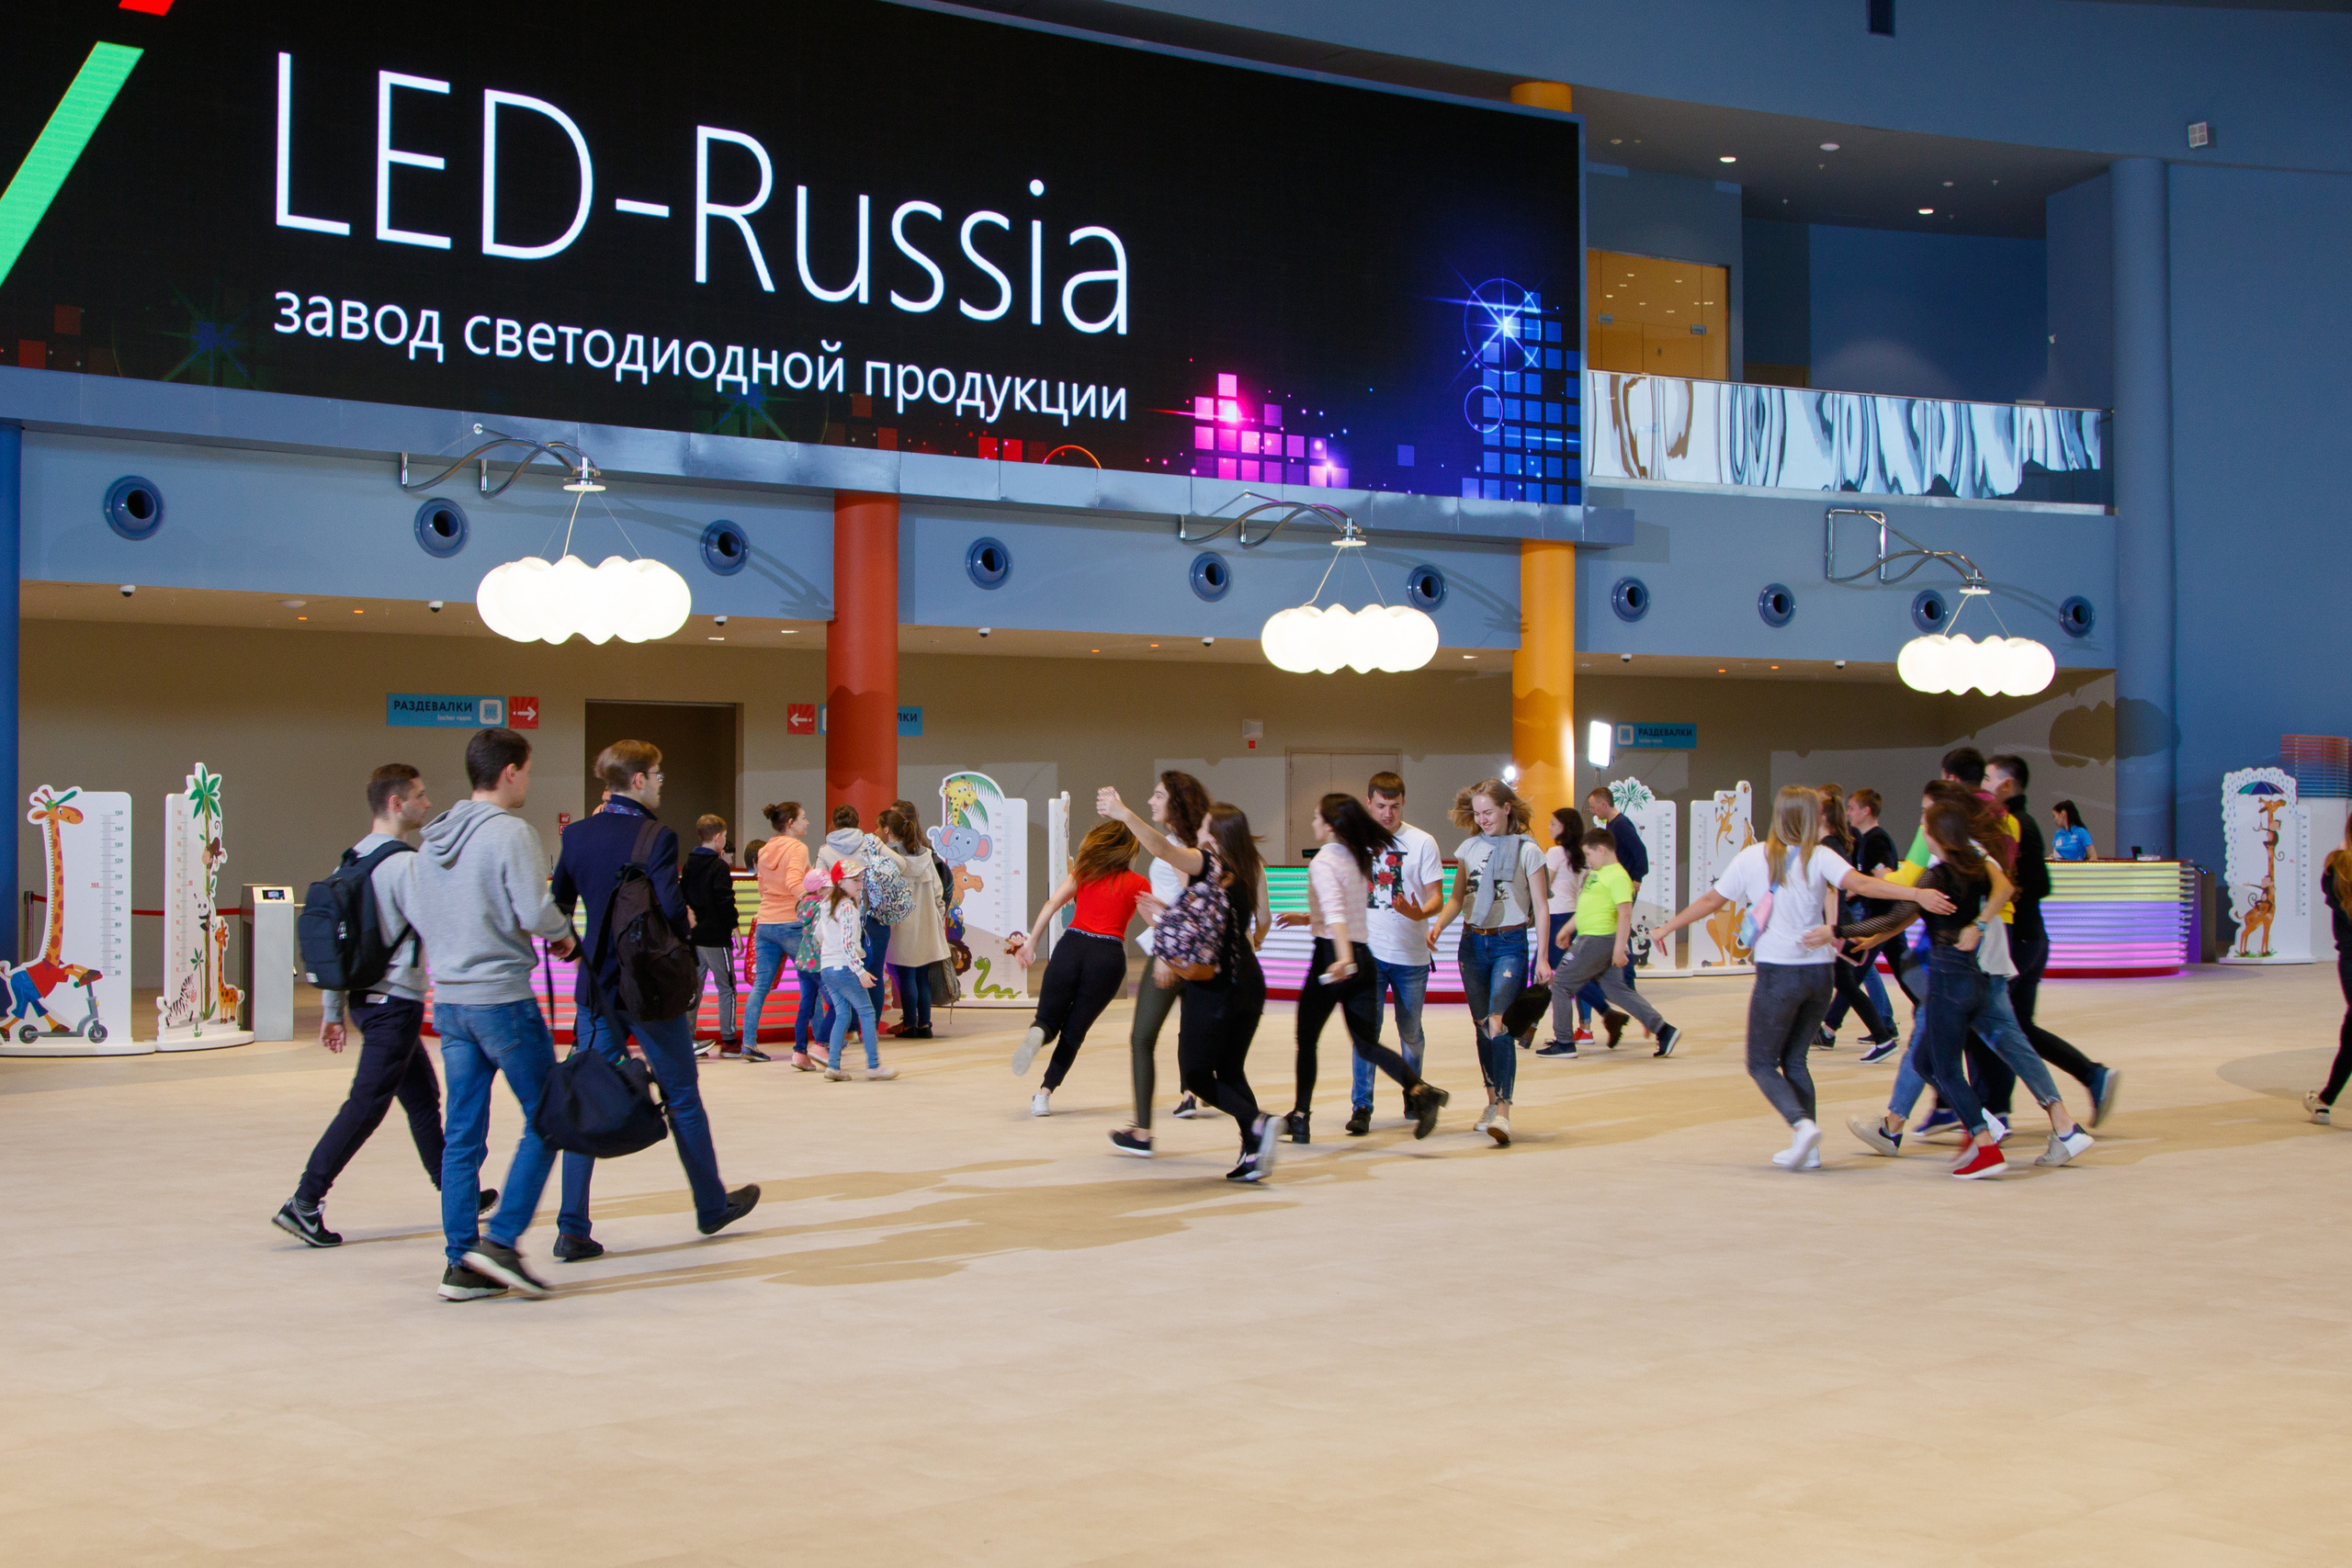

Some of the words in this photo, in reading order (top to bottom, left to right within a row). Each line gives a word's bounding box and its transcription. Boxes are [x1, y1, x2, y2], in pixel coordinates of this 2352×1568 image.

[276, 51, 1128, 334] LED-Russia
[273, 290, 445, 364] завод
[463, 315, 844, 395] светодиодной
[865, 360, 1127, 427] продукции
[393, 700, 472, 713] РАЗДЕВАЛКИ
[1638, 728, 1692, 738] РАЗДЕВАЛКИ
